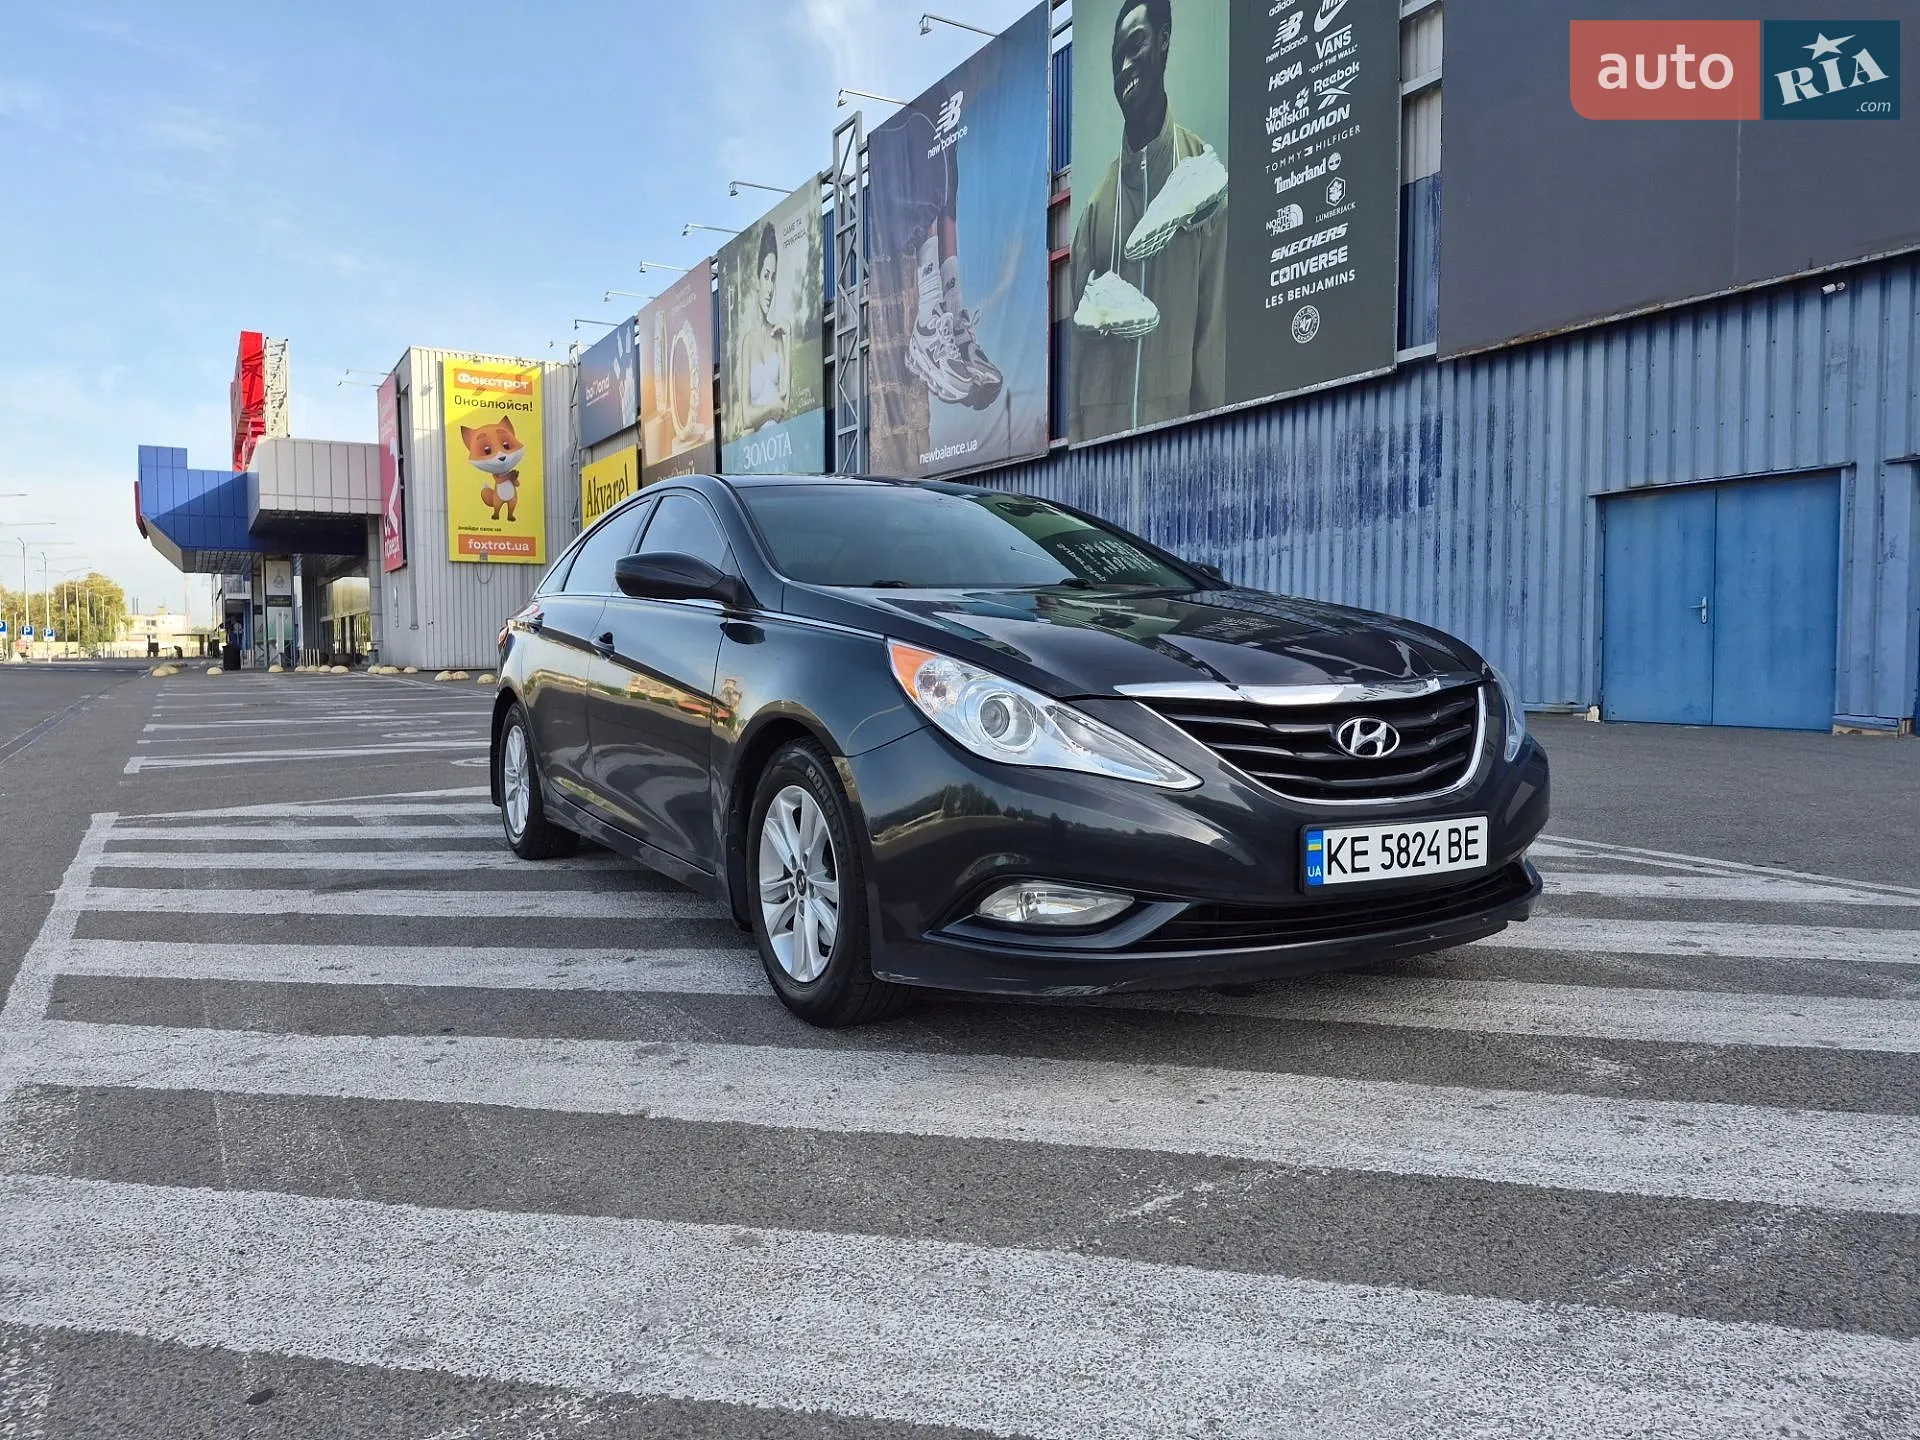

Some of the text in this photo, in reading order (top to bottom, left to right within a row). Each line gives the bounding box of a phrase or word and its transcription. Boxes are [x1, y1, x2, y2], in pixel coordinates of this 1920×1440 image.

[1280, 35, 1309, 56] balance
[1315, 24, 1353, 59] VANS
[1268, 61, 1303, 92] HOKA
[1313, 61, 1360, 93] Reebok
[1265, 106, 1309, 135] Wolfskin
[1266, 100, 1290, 121] Jack
[927, 125, 968, 159] new balance
[1271, 104, 1351, 153] SALOMON
[1265, 124, 1361, 174] TOMMY HILFIGER
[1274, 158, 1327, 194] Timberland
[1266, 216, 1290, 230] NORTH
[1276, 205, 1291, 218] THE
[1315, 201, 1356, 223] LUMBERJACK
[1270, 222, 1349, 263] SKECHERS
[1270, 245, 1348, 287] CONVERSE
[1265, 269, 1356, 309] LES BENJAMINS
[457, 372, 529, 390] Фокстрот
[454, 394, 533, 412] Оновлюйся!
[743, 431, 793, 470] ЗОЛОТА
[919, 438, 978, 465] newbalance.ua
[585, 462, 630, 518] Akvarel
[468, 538, 530, 551] foxtrot.ua
[1327, 825, 1479, 875] KE 5824 BE
[1307, 866, 1322, 877] UA
